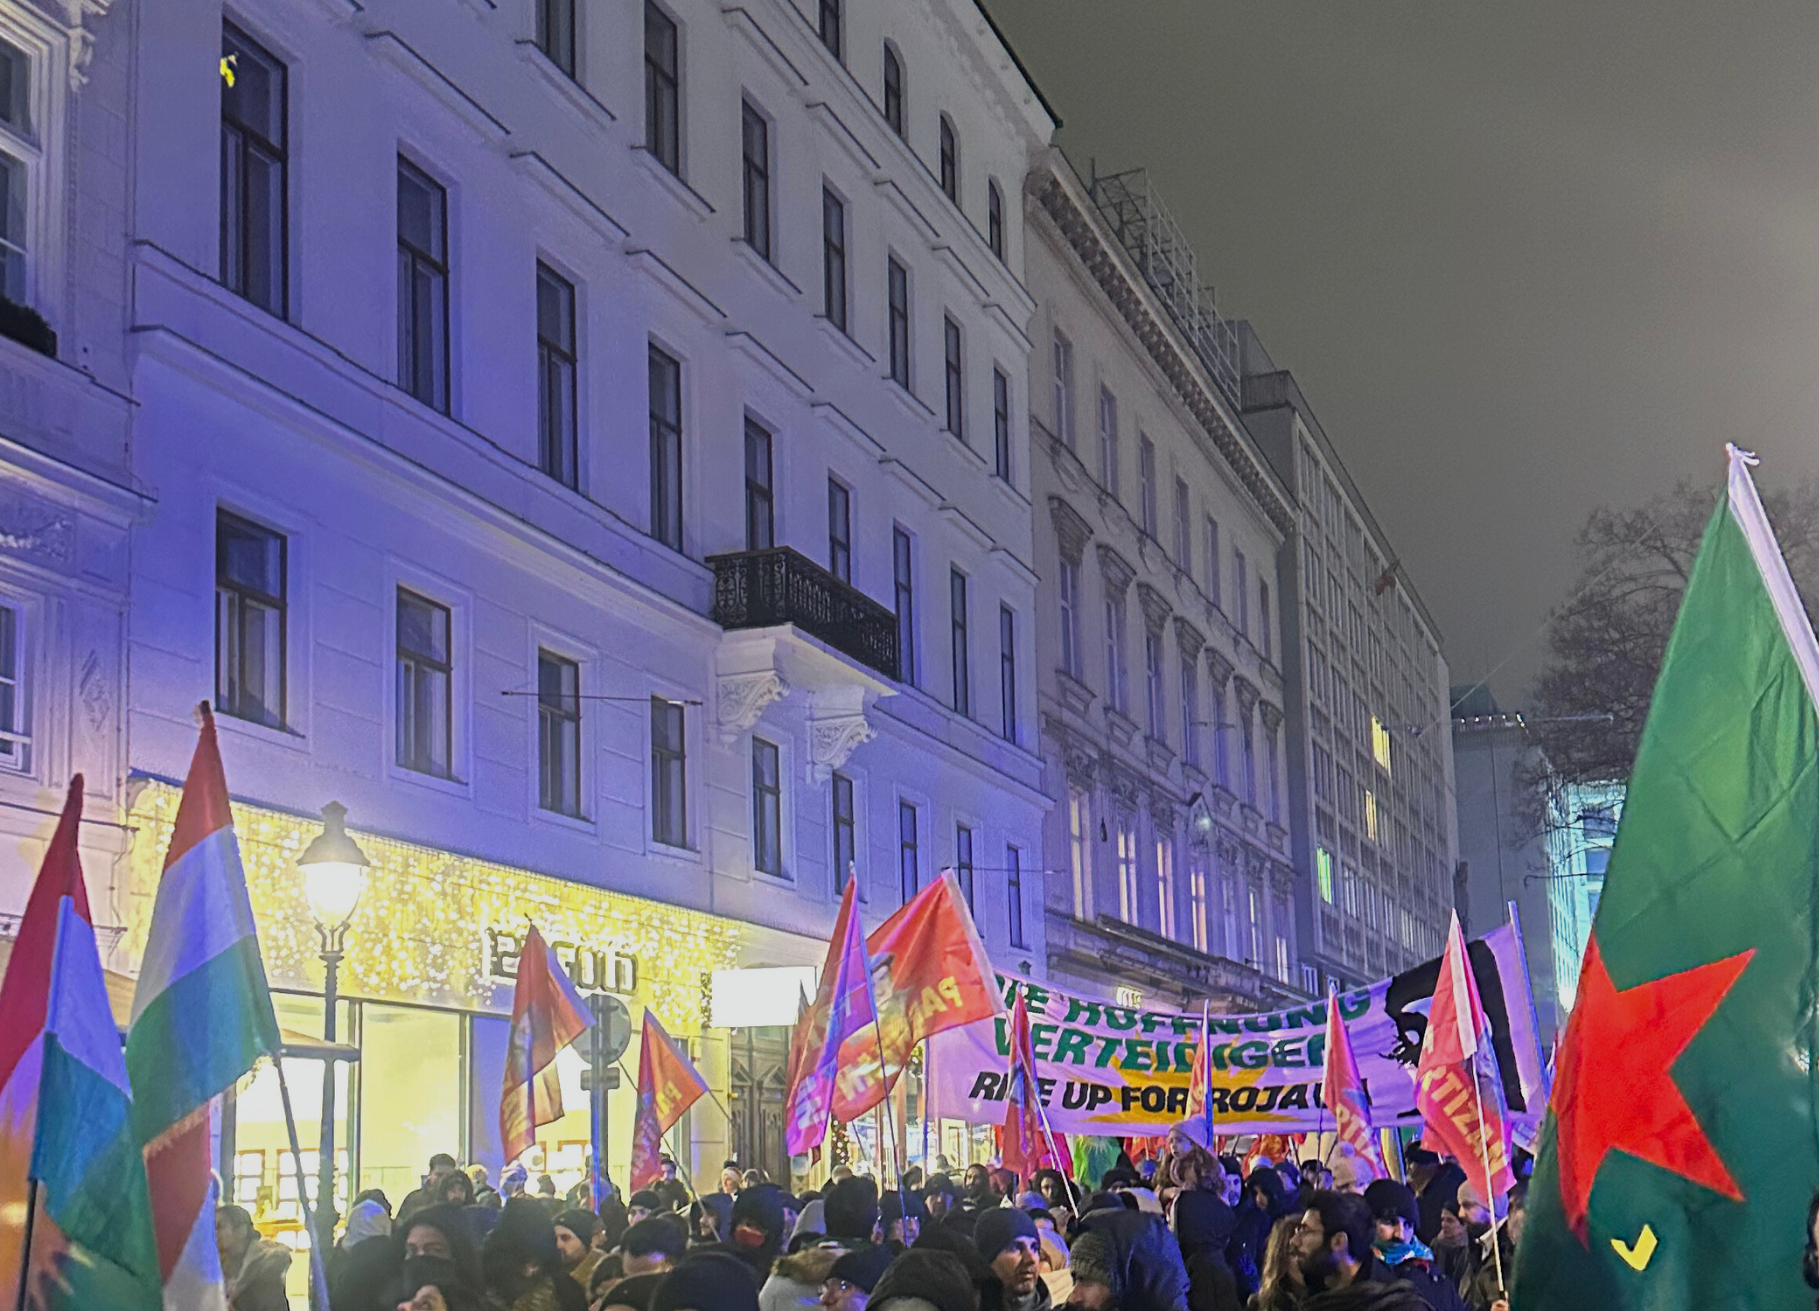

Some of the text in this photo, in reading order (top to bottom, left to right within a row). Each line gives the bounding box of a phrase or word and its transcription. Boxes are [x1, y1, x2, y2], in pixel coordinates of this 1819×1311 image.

[1063, 988, 1371, 1034] HOFFNUNG
[969, 1071, 1057, 1108] RIE
[1062, 1081, 1112, 1111] UP
[1121, 1085, 1189, 1115] FOR
[1212, 1078, 1372, 1113] ROJA
